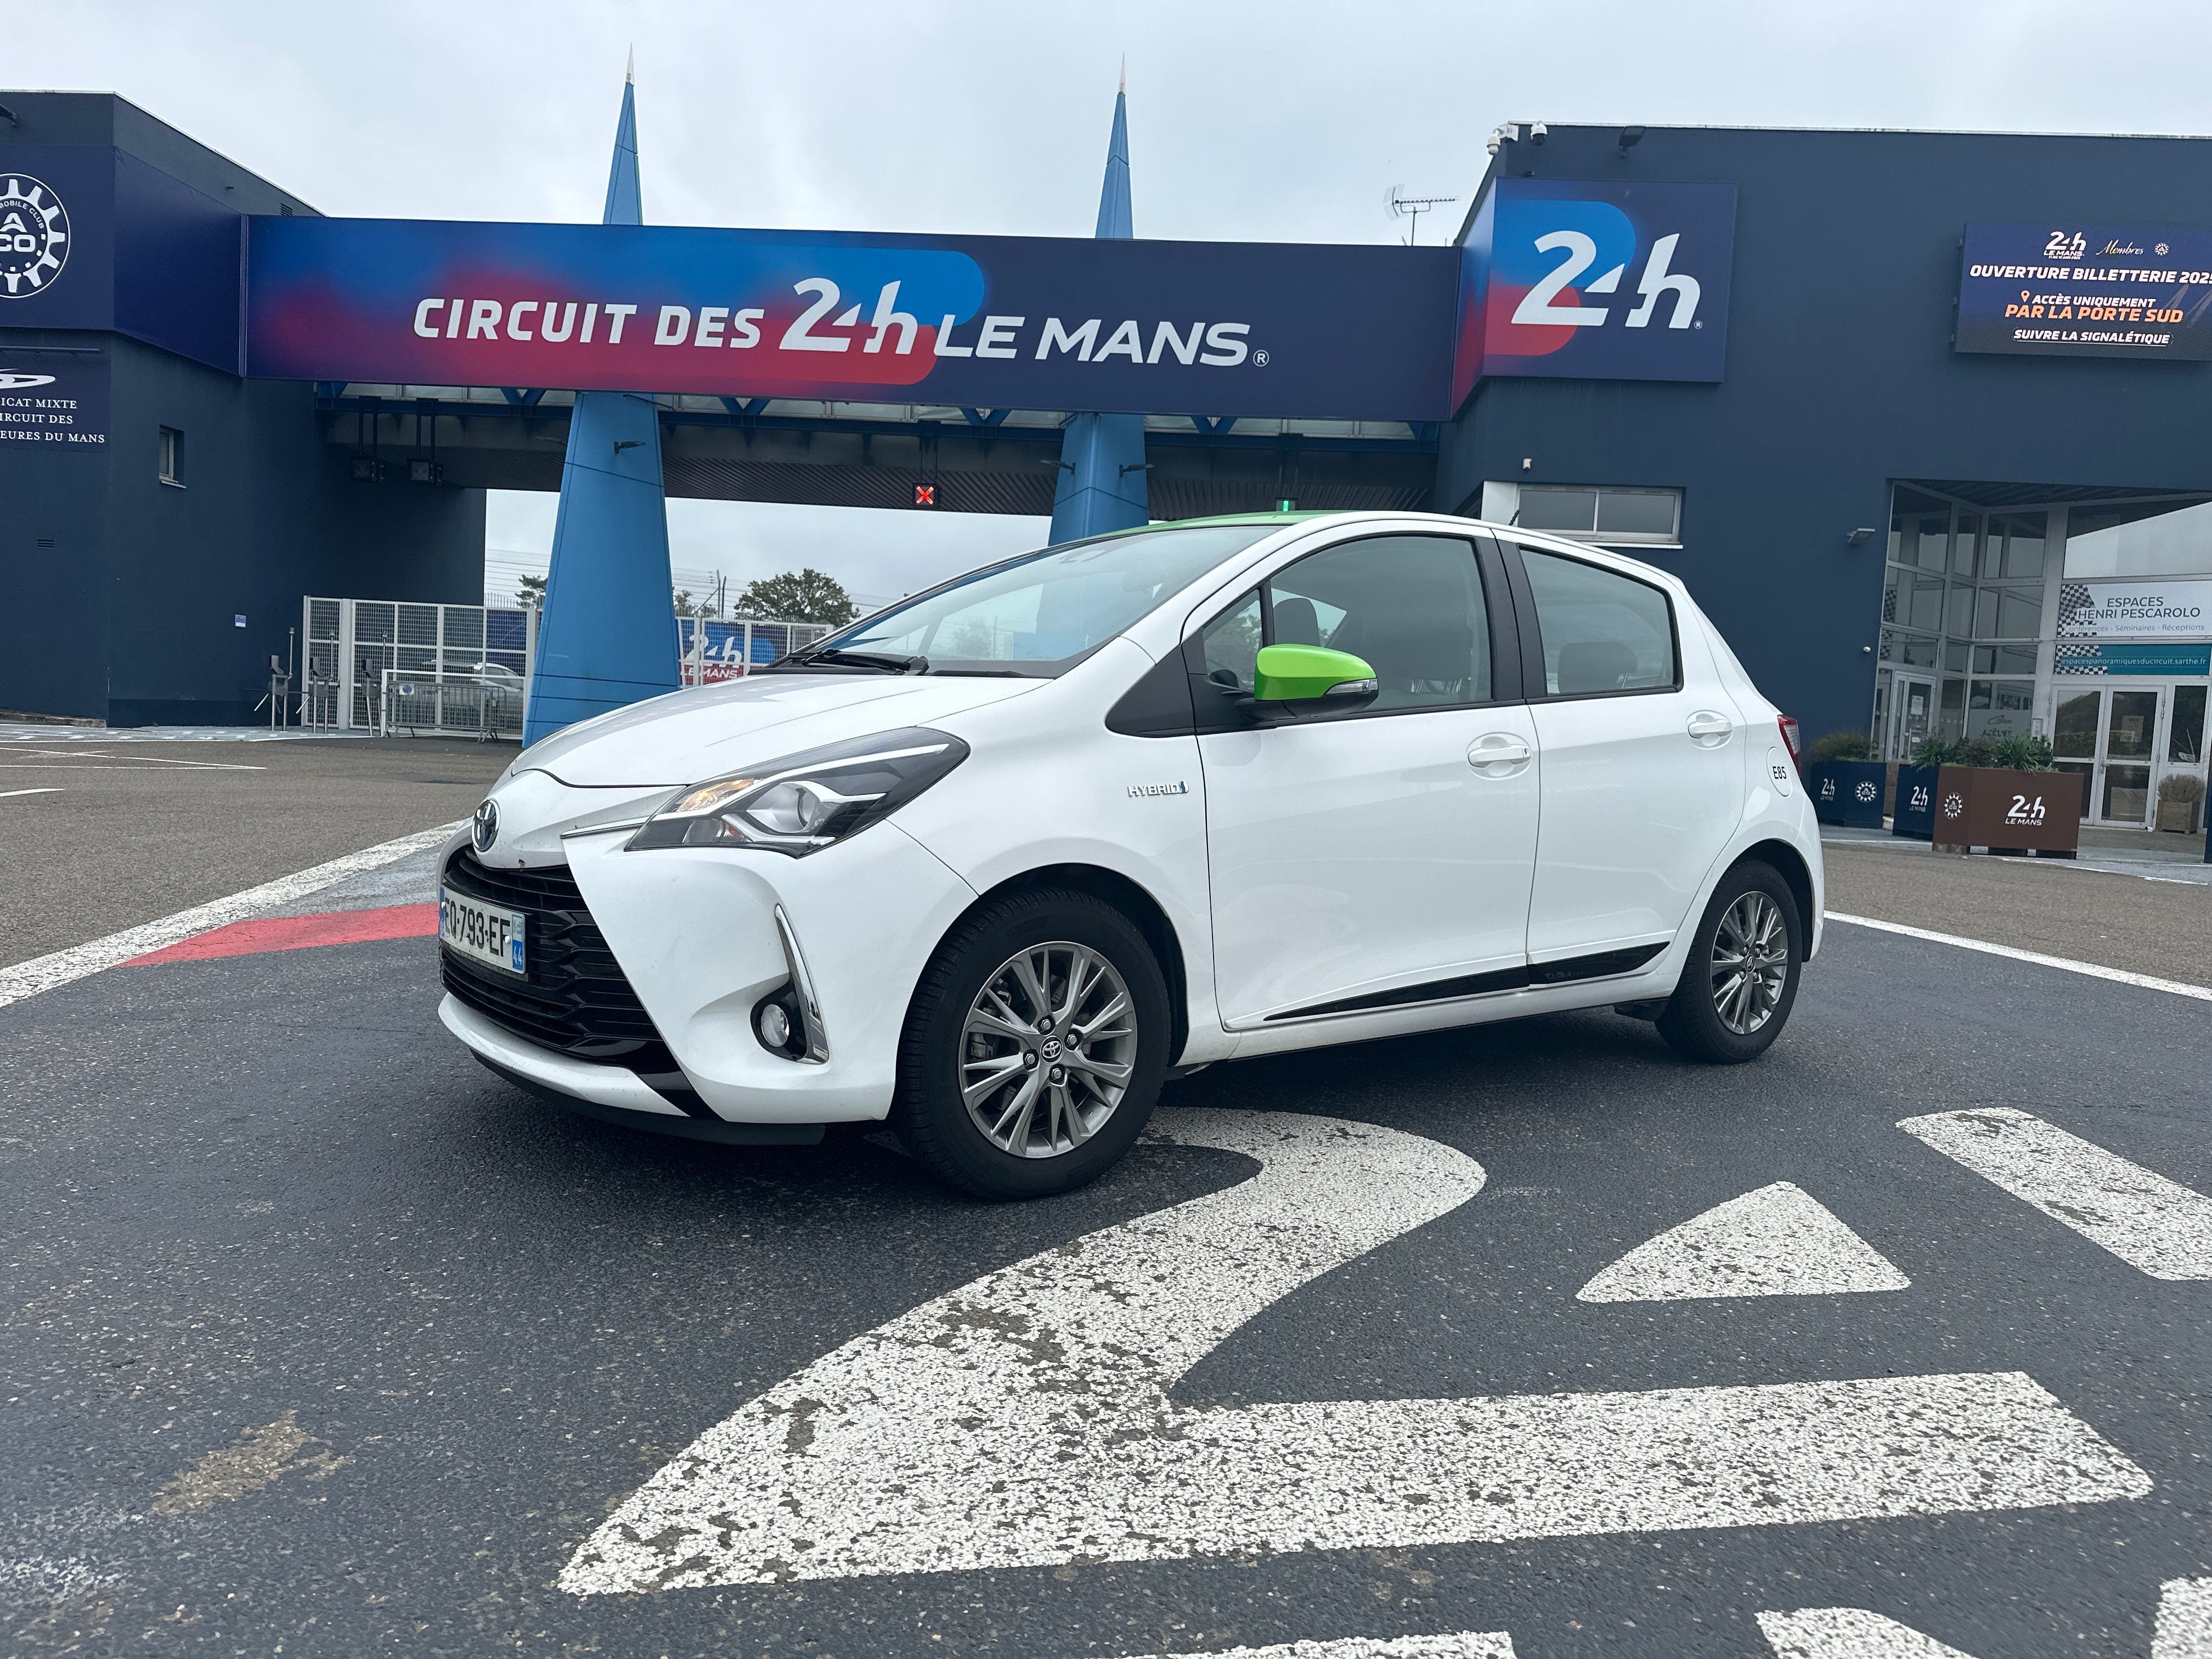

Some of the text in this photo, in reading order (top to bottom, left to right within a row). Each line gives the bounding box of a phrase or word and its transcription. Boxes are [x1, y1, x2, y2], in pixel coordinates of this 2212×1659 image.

[29, 208, 44, 229] CLUB
[2045, 231, 2144, 255] 24h Membres
[1511, 230, 1701, 329] 24h
[1970, 265, 2070, 279] OUVERTURE
[2072, 268, 2177, 283] BILLETTERIE
[2032, 293, 2156, 308] ACCÈS UNIQUEMENT
[413, 277, 1251, 366] CIRCUIT DES 24h LE MANS
[2005, 304, 2184, 323] PAR LA PORTE SUD
[2013, 329, 2170, 345] SUIVRE LA SIGNALÉTIQUE
[35, 399, 77, 409] MIXTE
[48, 415, 74, 424] DES
[44, 432, 63, 441] DU
[68, 433, 105, 443] MANS
[2107, 597, 2164, 607] ESPACES
[2078, 607, 2200, 619] HENRI PESCAROLO
[2162, 624, 2205, 632] Réceptions
[1773, 766, 1787, 779] E85
[1127, 784, 1180, 797] HYBRID
[1910, 786, 1928, 806] 24h
[2007, 795, 2046, 819] 24h
[513, 945, 523, 966] 44
